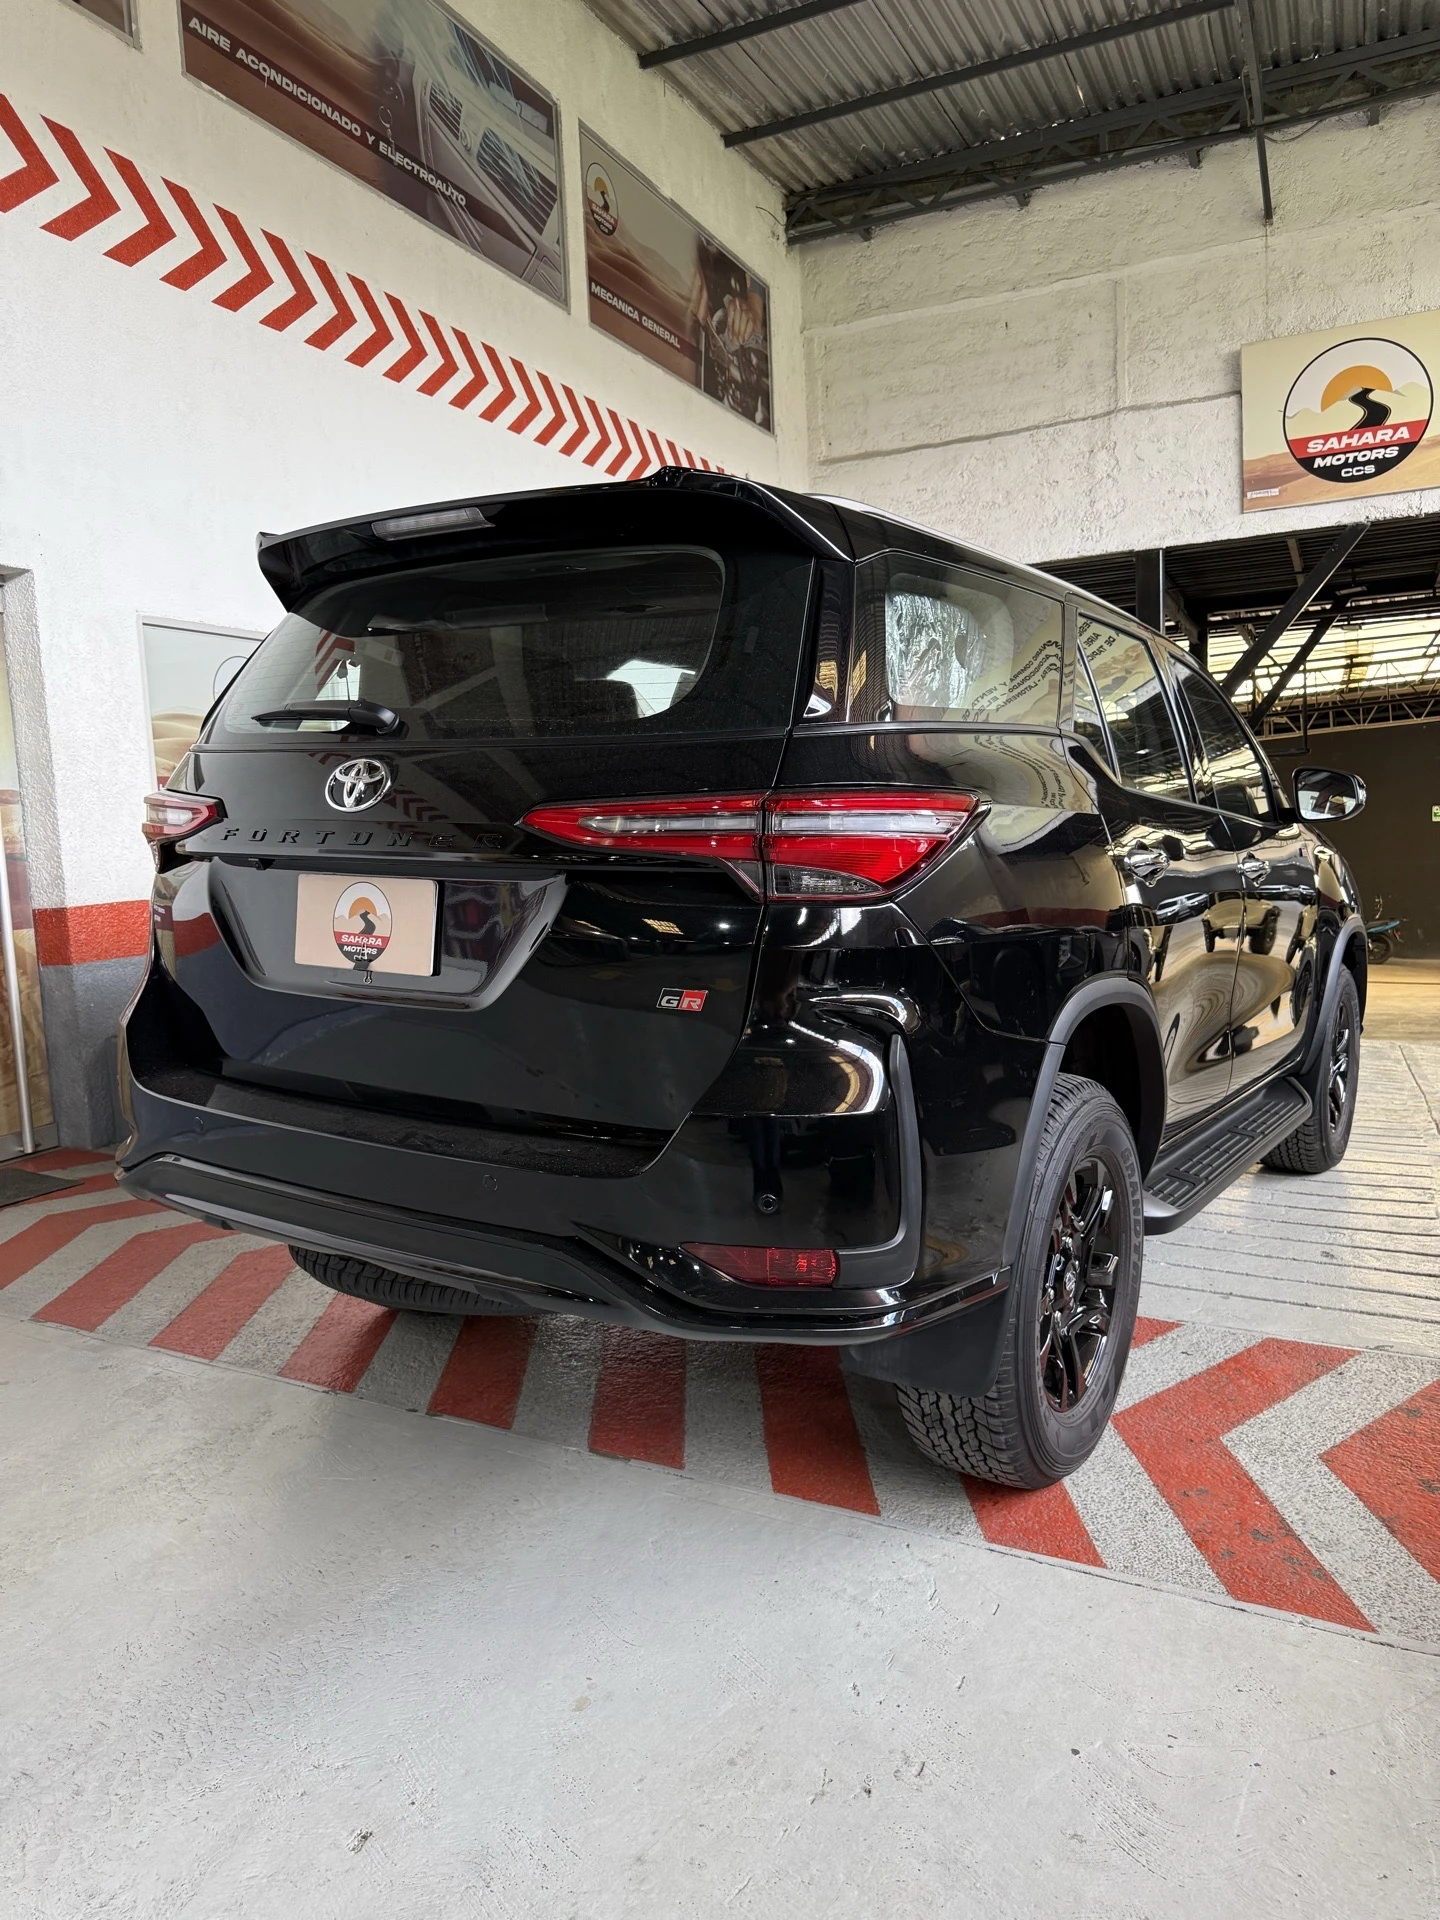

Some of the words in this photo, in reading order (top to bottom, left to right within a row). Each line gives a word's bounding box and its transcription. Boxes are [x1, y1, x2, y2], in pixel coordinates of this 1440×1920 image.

[188, 17, 231, 52] AIRE
[236, 47, 361, 137] ACONDICIONADO
[366, 131, 375, 145] Y
[379, 142, 467, 207] ELECTROAUTO
[591, 281, 640, 323] MECANICA
[642, 315, 681, 349] GENERAL
[1306, 426, 1410, 454] SAHARA
[1313, 446, 1400, 469] MOTORS
[1341, 464, 1375, 478] CCS
[220, 827, 502, 849] FORTUNER
[660, 995, 701, 1009] GR
